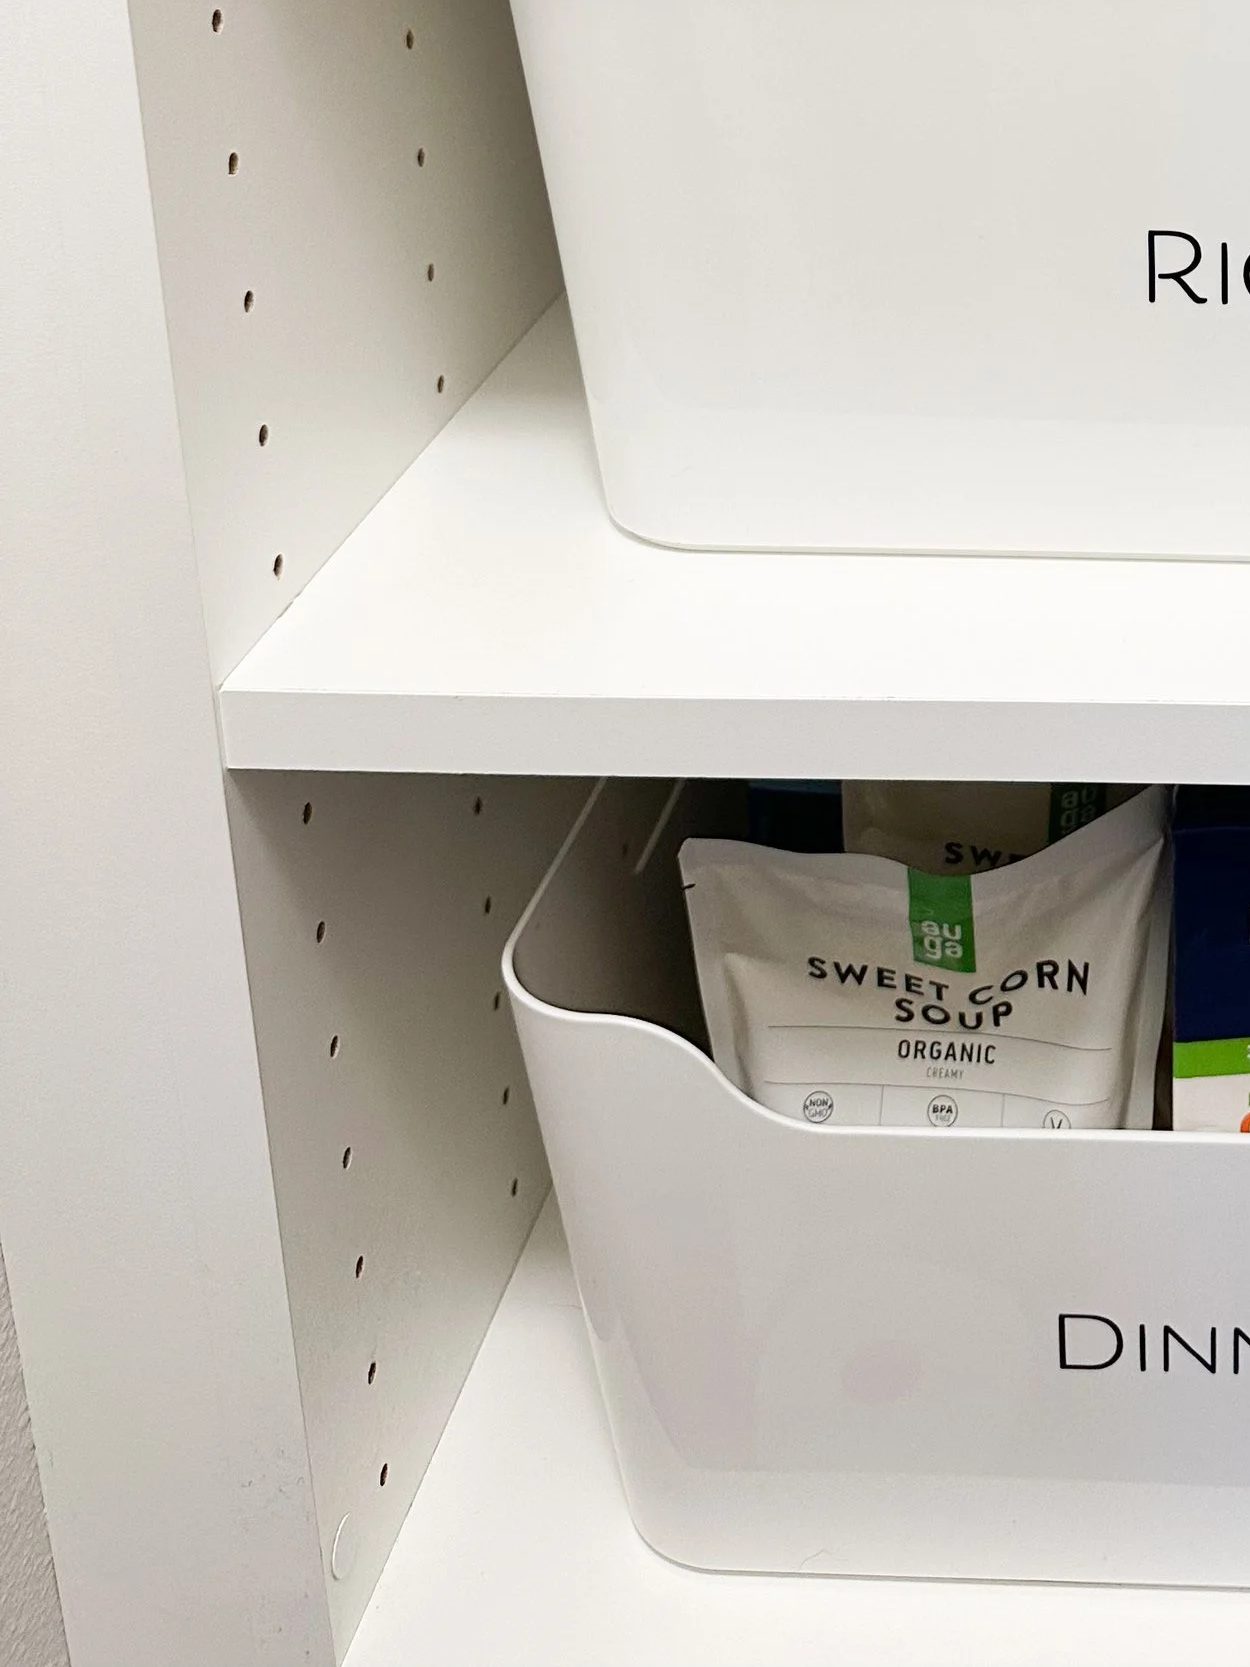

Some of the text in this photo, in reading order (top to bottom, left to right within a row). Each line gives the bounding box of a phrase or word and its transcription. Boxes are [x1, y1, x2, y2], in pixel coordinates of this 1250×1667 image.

[807, 956, 1090, 1006] SWEET CORN
[895, 998, 1013, 1030] SOUP
[897, 1038, 996, 1064] ORGANIC
[932, 1103, 953, 1114] BPA
